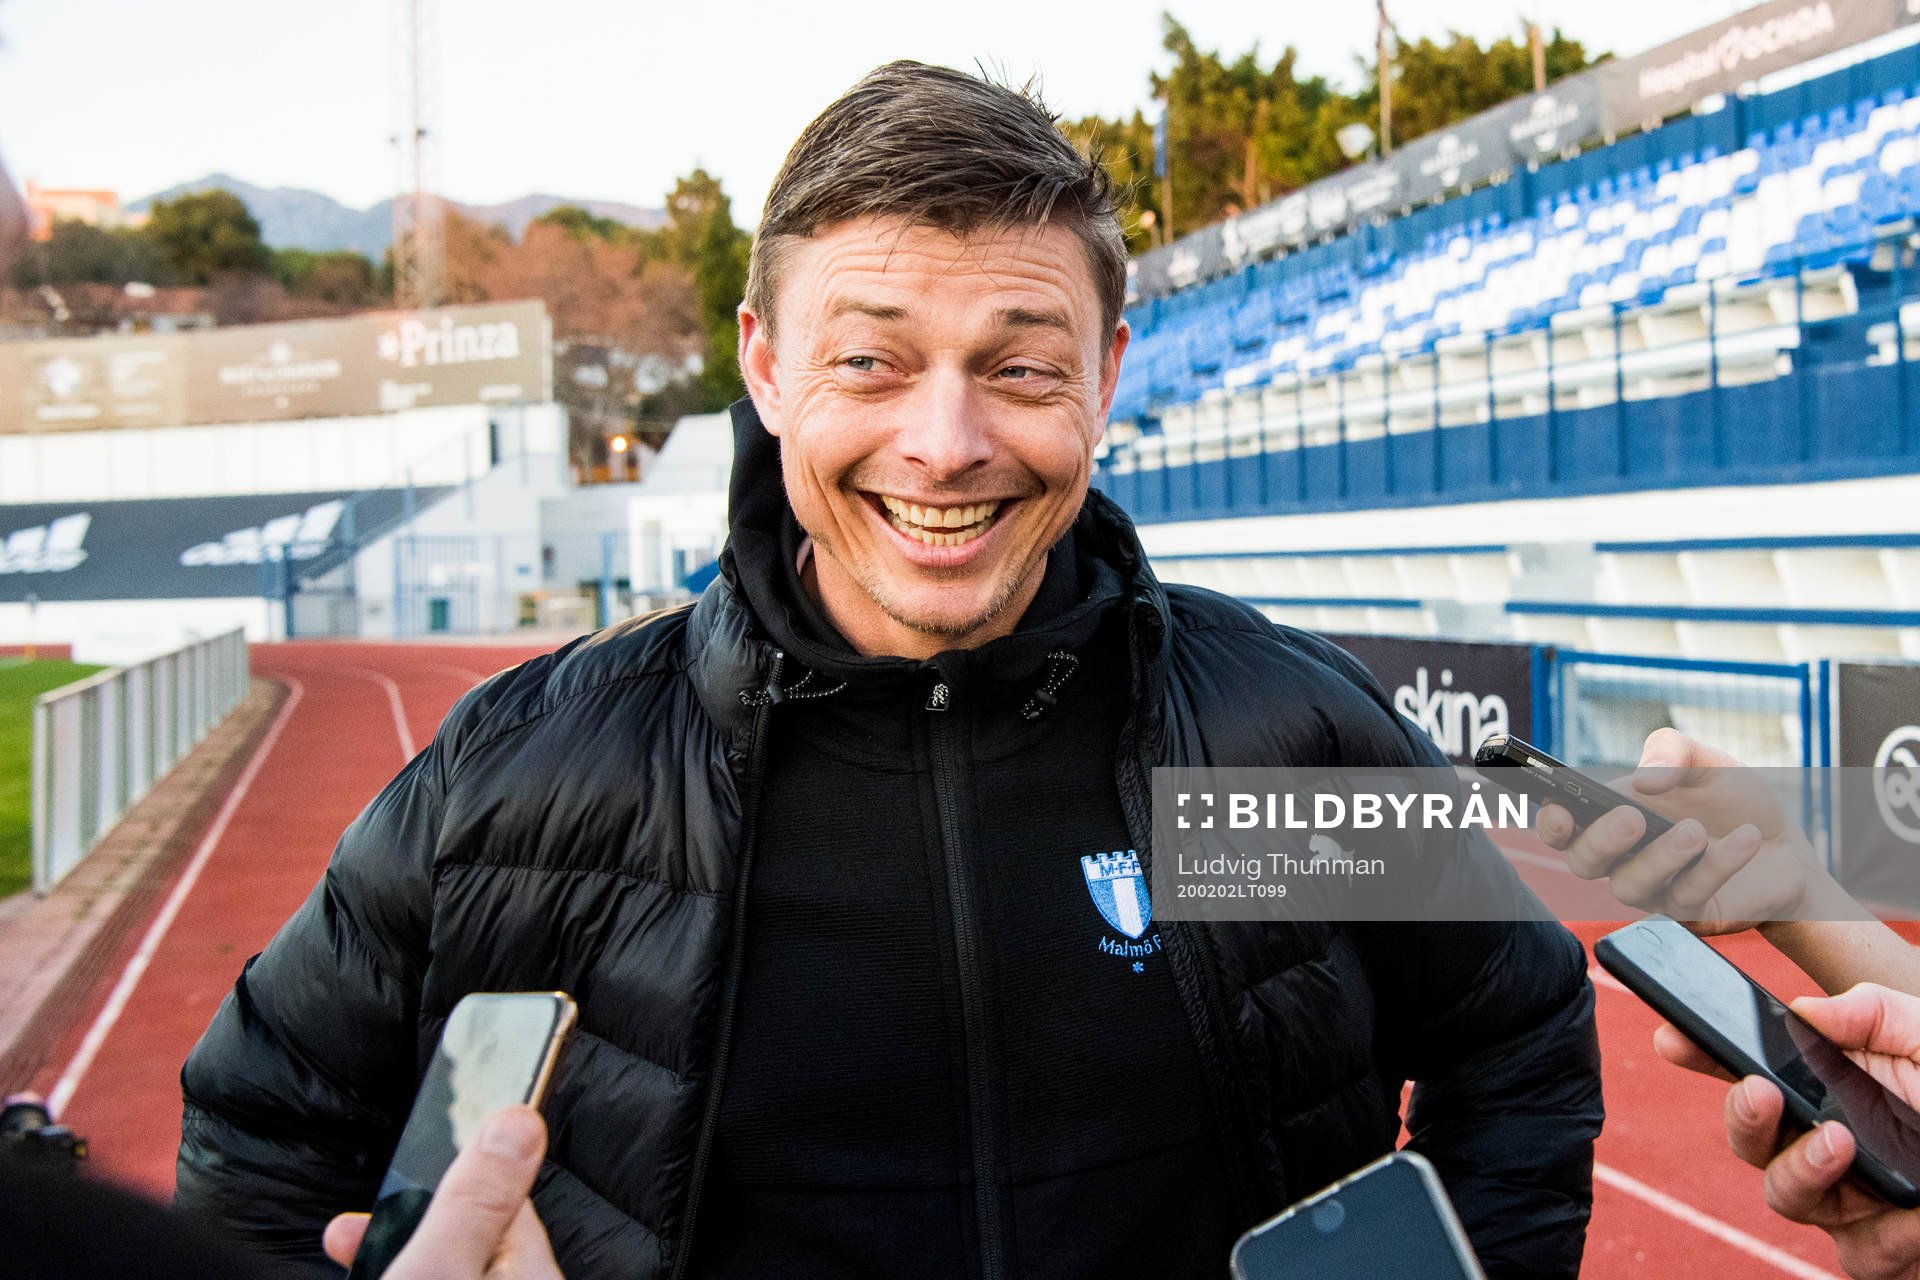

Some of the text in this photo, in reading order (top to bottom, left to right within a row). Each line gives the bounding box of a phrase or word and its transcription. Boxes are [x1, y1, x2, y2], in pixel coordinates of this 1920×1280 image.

[400, 316, 519, 367] Prinza
[1394, 666, 1508, 761] skina
[1098, 935, 1153, 957] Malmö
